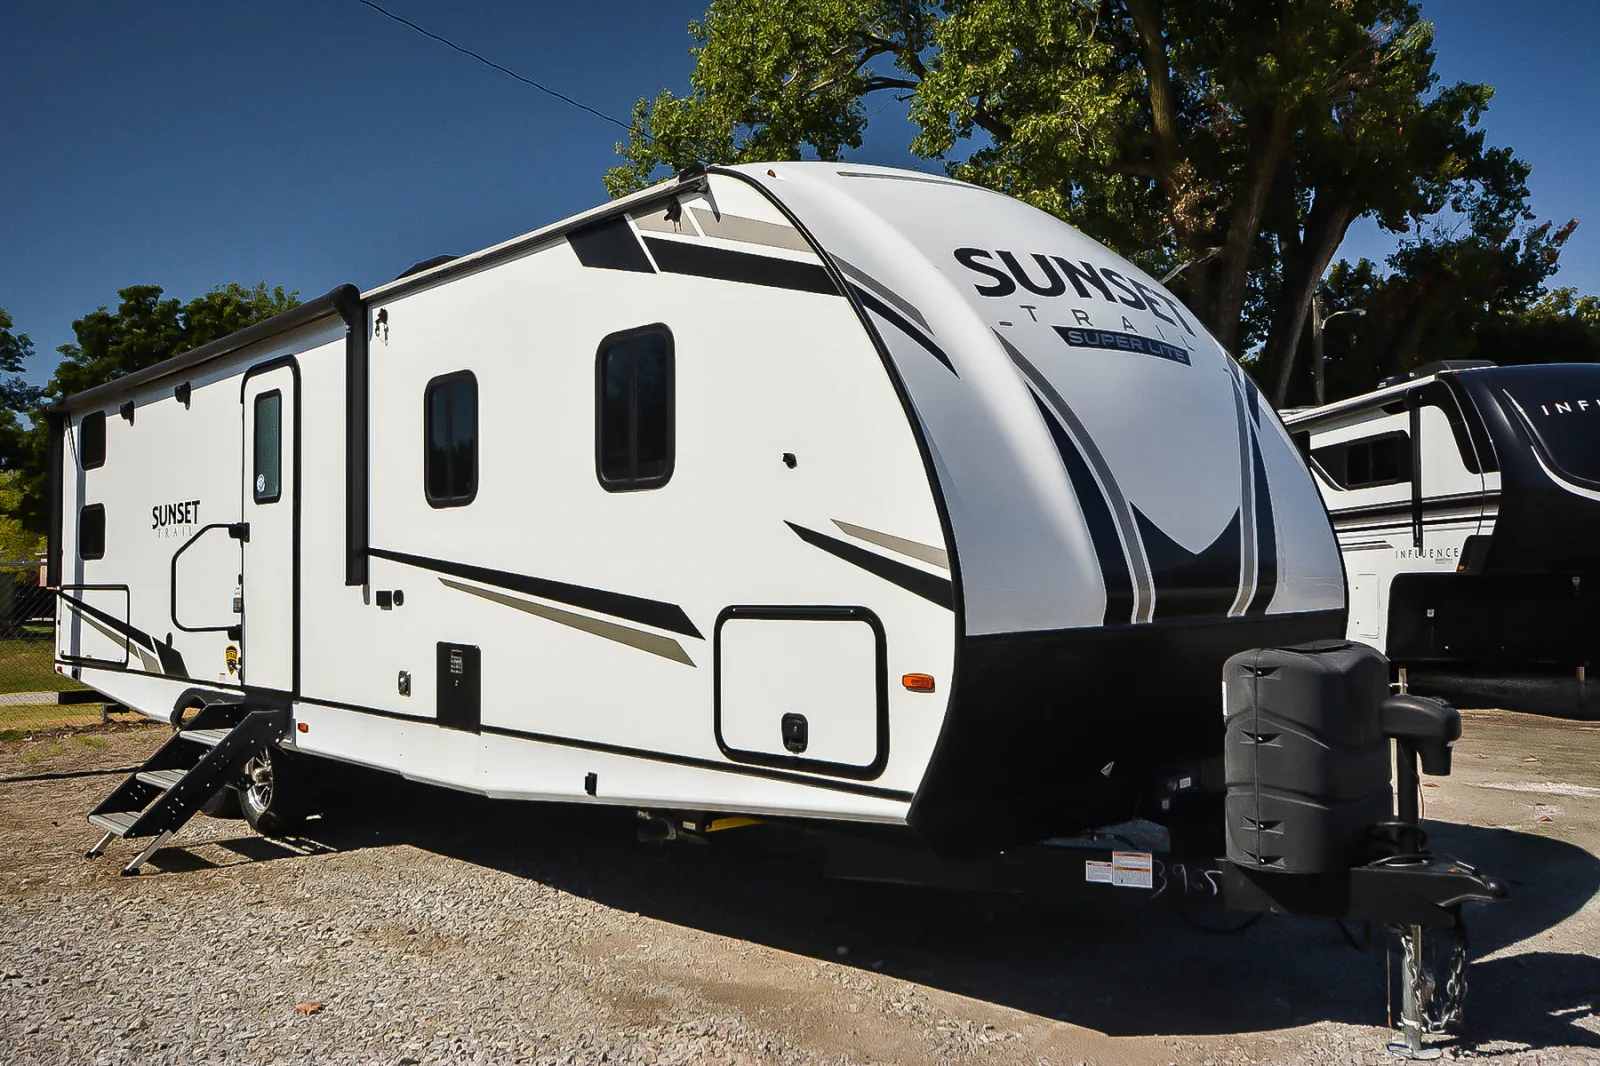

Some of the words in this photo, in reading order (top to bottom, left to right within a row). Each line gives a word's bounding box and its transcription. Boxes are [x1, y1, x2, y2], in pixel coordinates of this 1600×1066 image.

[953, 247, 1197, 338] SUNSET
[1019, 304, 1196, 352] TRAIL
[1068, 331, 1145, 350] SUPER
[1147, 340, 1186, 362] LITE
[152, 500, 200, 530] SUNSET
[157, 526, 193, 539] TRAIL
[1395, 547, 1459, 559] INFLUENCE
